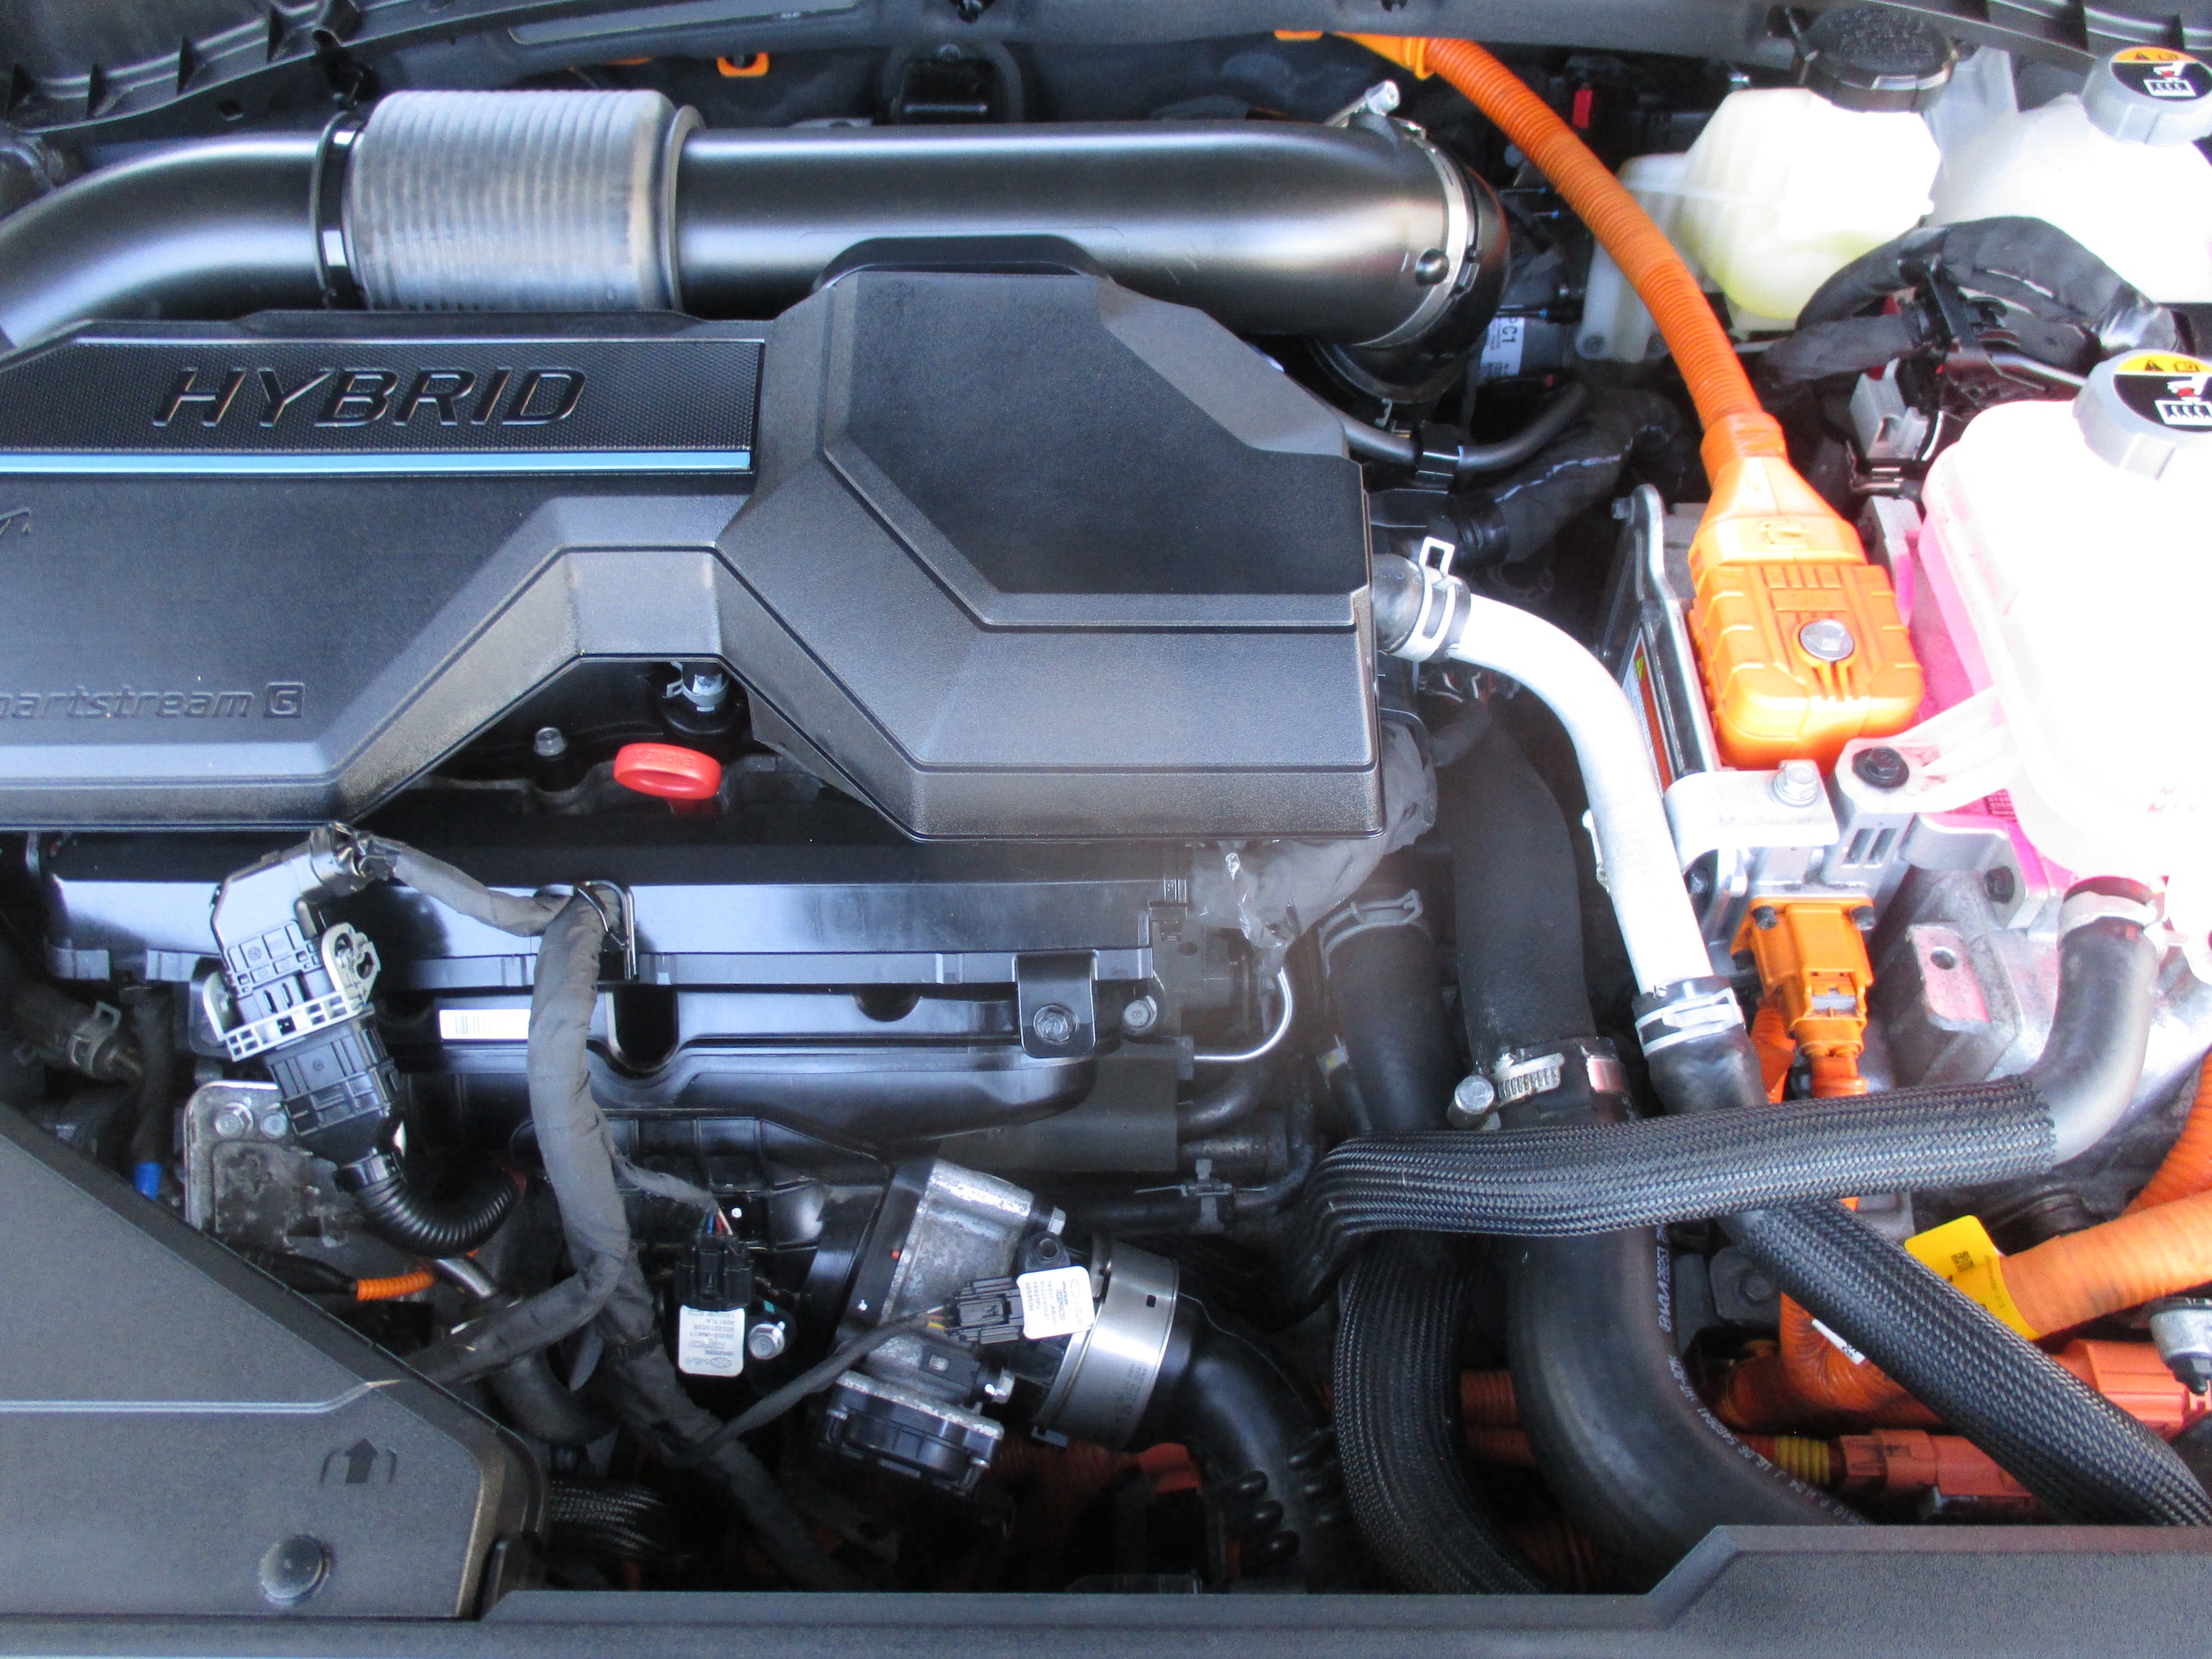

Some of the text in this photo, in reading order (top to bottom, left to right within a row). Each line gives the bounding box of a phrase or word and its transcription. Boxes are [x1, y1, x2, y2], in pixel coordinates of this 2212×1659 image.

[151, 366, 587, 428] HYBRID
[266, 685, 302, 717] G
[647, 750, 695, 770] ENGINE
